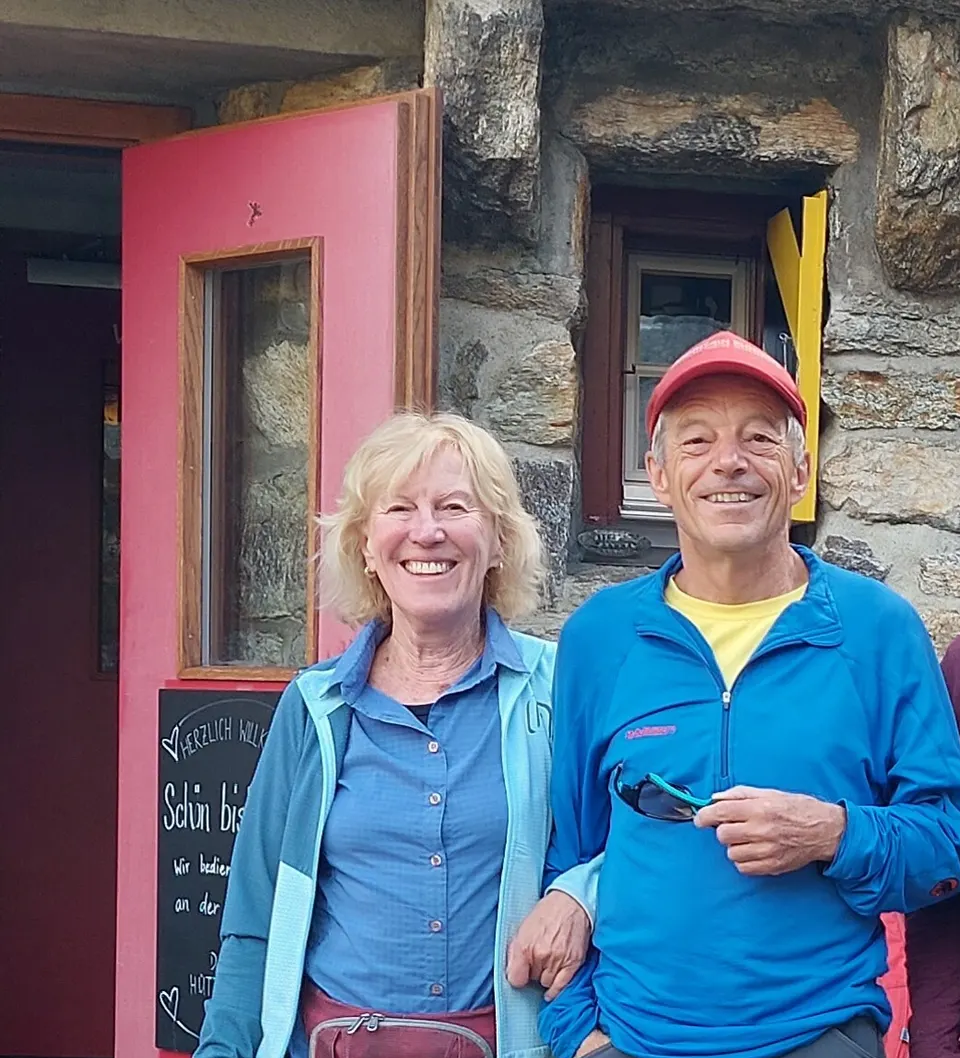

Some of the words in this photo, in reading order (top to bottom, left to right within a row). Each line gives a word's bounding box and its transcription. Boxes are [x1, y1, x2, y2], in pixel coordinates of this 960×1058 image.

[180, 716, 232, 760] HERZLICH
[239, 718, 269, 748] WILLK
[163, 781, 210, 833] Schön
[220, 782, 245, 833] bis
[173, 857, 190, 876] Wir
[175, 898, 190, 913] an
[199, 891, 221, 915] der
[190, 973, 216, 997] HÜT
